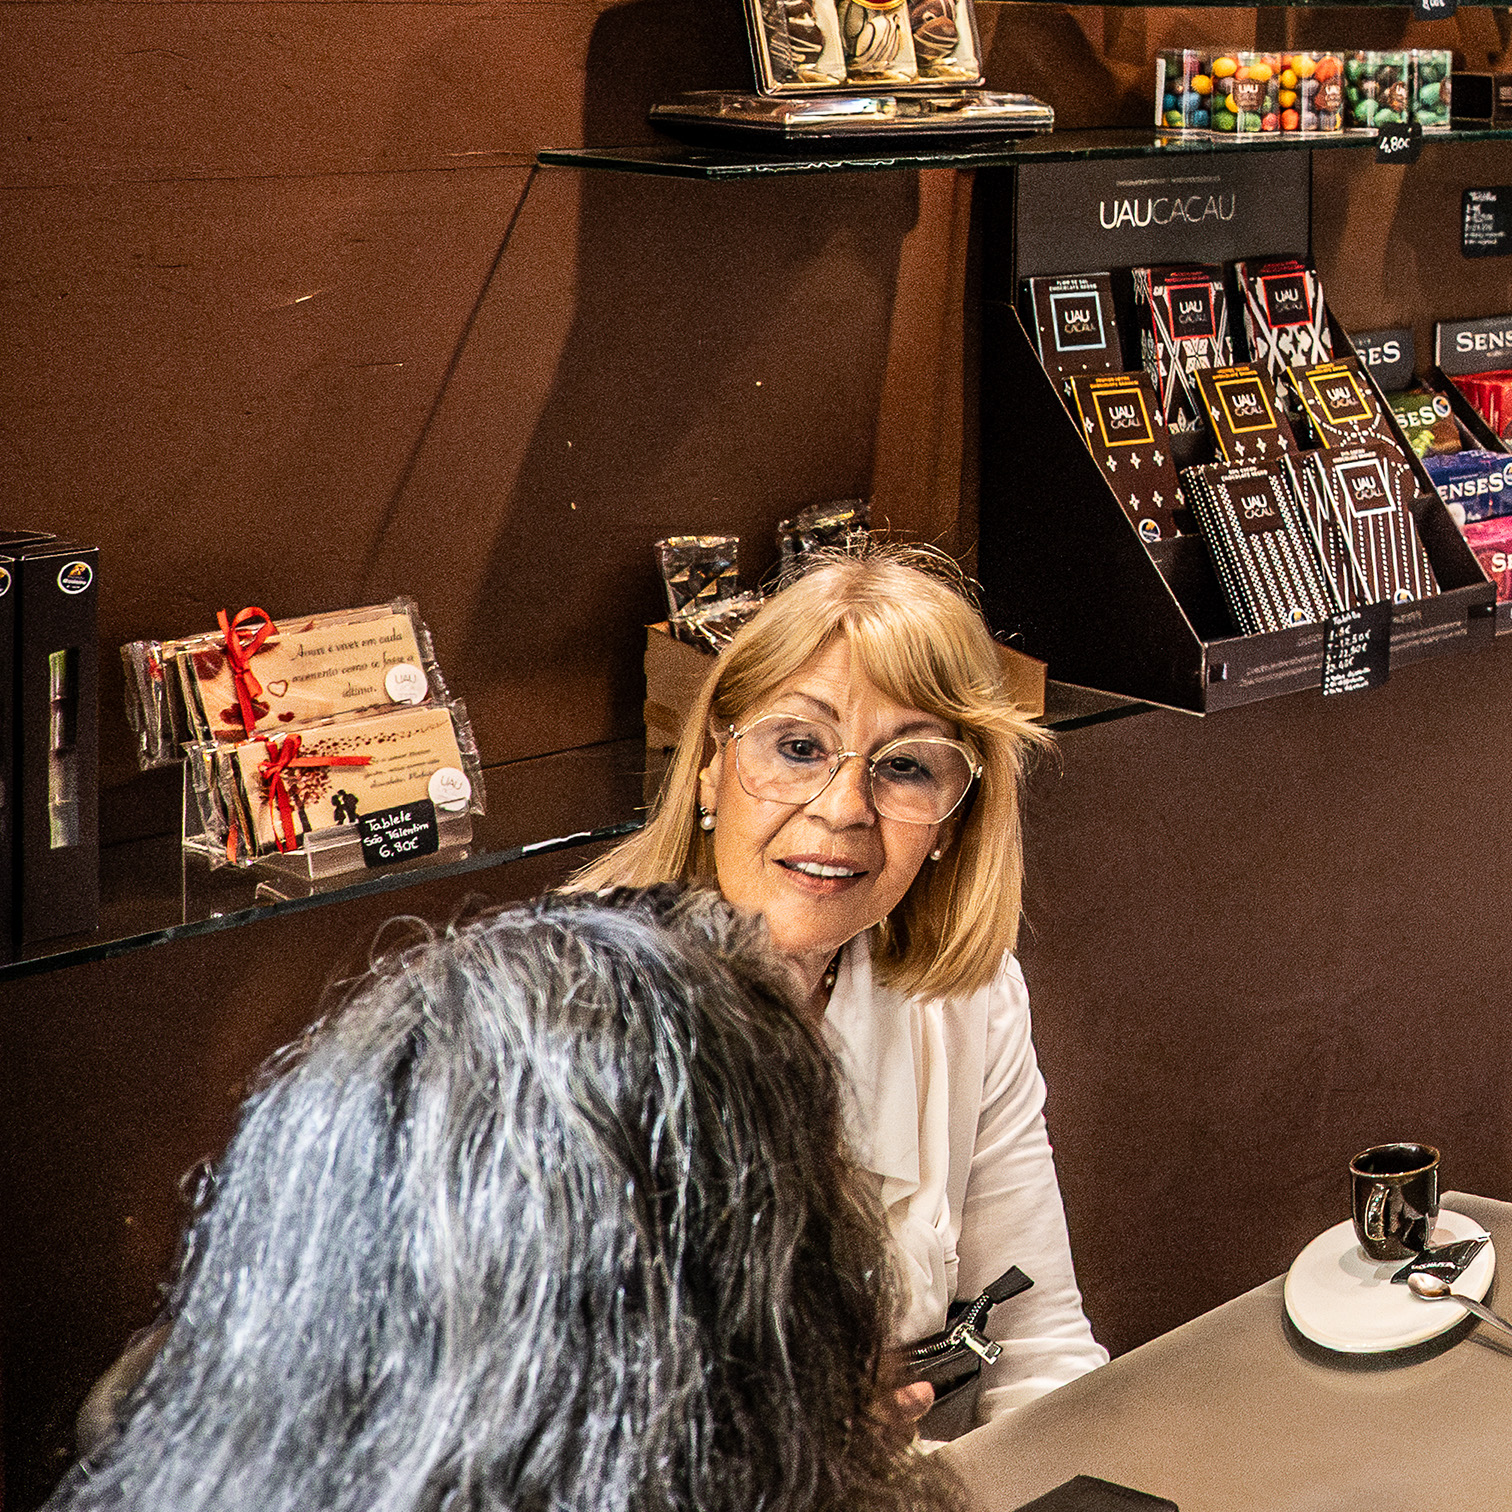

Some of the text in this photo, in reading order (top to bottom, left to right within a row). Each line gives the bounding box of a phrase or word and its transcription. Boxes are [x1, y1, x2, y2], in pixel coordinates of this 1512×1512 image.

[1100, 193, 1236, 230] UAUCACAU
[1274, 288, 1299, 302] UAU
[1179, 299, 1203, 315] UAU
[1064, 309, 1091, 324] UAU
[1231, 392, 1257, 408] UAU
[1326, 387, 1351, 401] UAU
[1108, 404, 1136, 420] UAU
[1351, 475, 1377, 491] UAU
[1240, 493, 1268, 510] UAU
